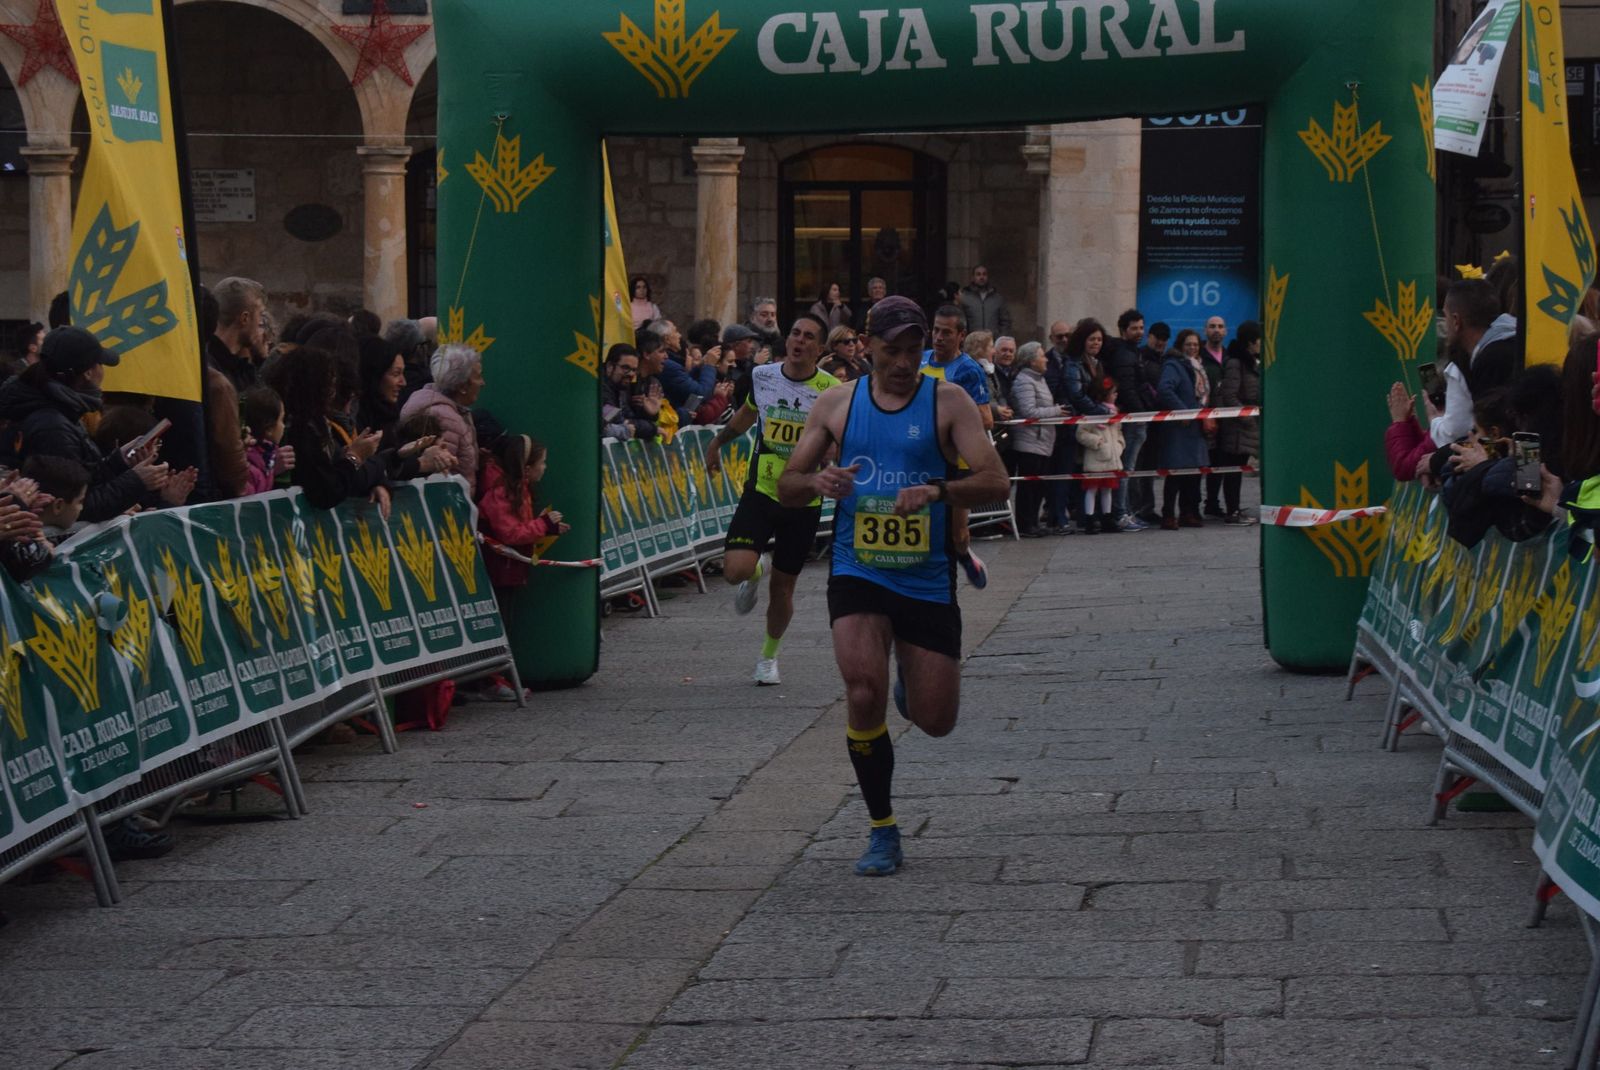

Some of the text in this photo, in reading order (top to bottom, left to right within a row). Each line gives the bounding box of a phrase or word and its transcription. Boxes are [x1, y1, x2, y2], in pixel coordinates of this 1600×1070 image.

[757, 0, 1246, 76] CAJA RURAL
[1147, 195, 1172, 203] Desde
[1173, 195, 1180, 203] la
[1208, 195, 1245, 205] Municipal
[1148, 206, 1243, 214] de Zamora te ofrecemos
[1151, 217, 1241, 227] nuestra ayuda cuando
[1163, 228, 1227, 236] más la necesitas
[1168, 281, 1221, 306] 016
[862, 517, 921, 546] 385
[875, 554, 923, 564] CAJA RURAL
[371, 620, 392, 638] CAJA
[62, 711, 136, 759] CAJA RURAL
[80, 741, 131, 773] DE ZAMORA
[1576, 833, 1600, 870] ZAMO
